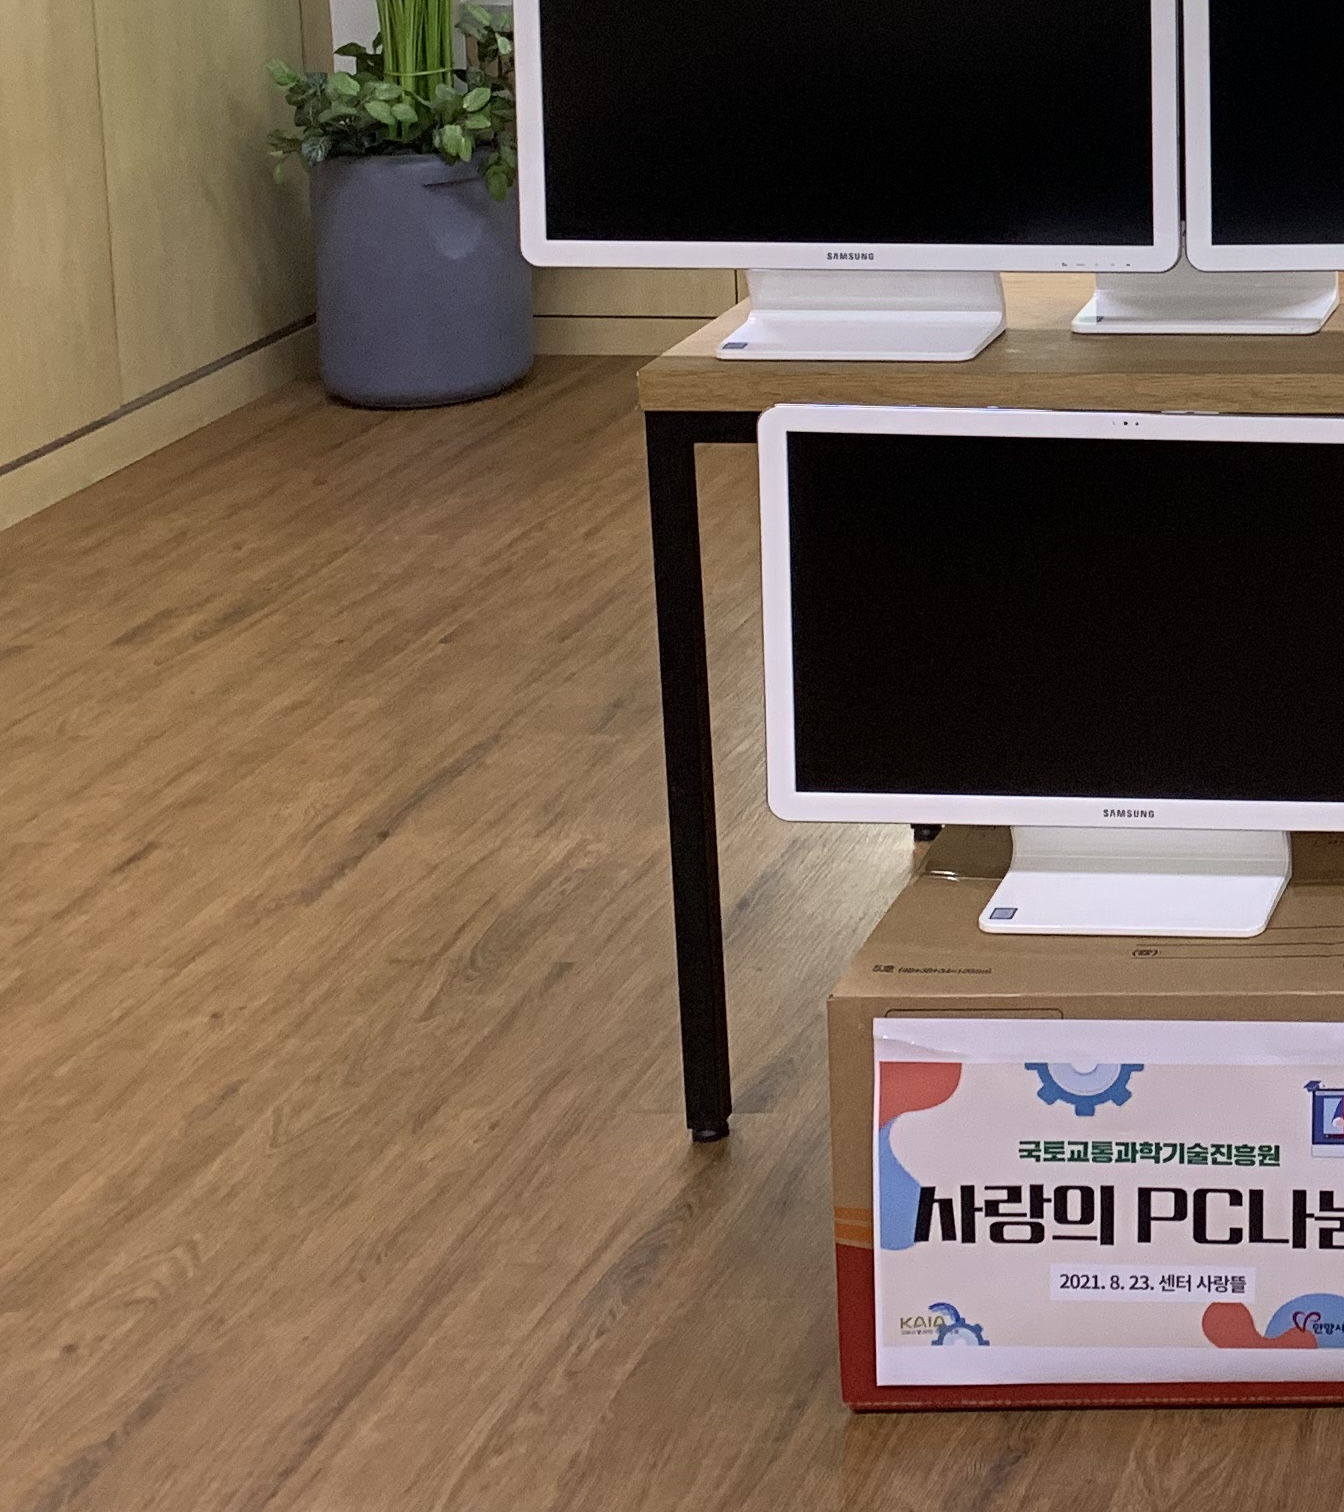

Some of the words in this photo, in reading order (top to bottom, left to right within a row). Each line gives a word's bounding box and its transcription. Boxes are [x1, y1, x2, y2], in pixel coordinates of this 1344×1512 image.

[827, 252, 875, 261] SAMSUNG
[1103, 809, 1155, 819] SAMSUNG
[1018, 1140, 1281, 1167] 국토교통과학기술진흥원
[913, 1183, 1115, 1246] 사랑의
[1060, 1273, 1106, 1290] 2021.
[1109, 1274, 1125, 1291] 8.
[1129, 1274, 1155, 1291] 23.
[1158, 1273, 1192, 1293] 센터
[1196, 1274, 1247, 1294] 사랑뜰
[899, 1315, 946, 1329] KAIA
